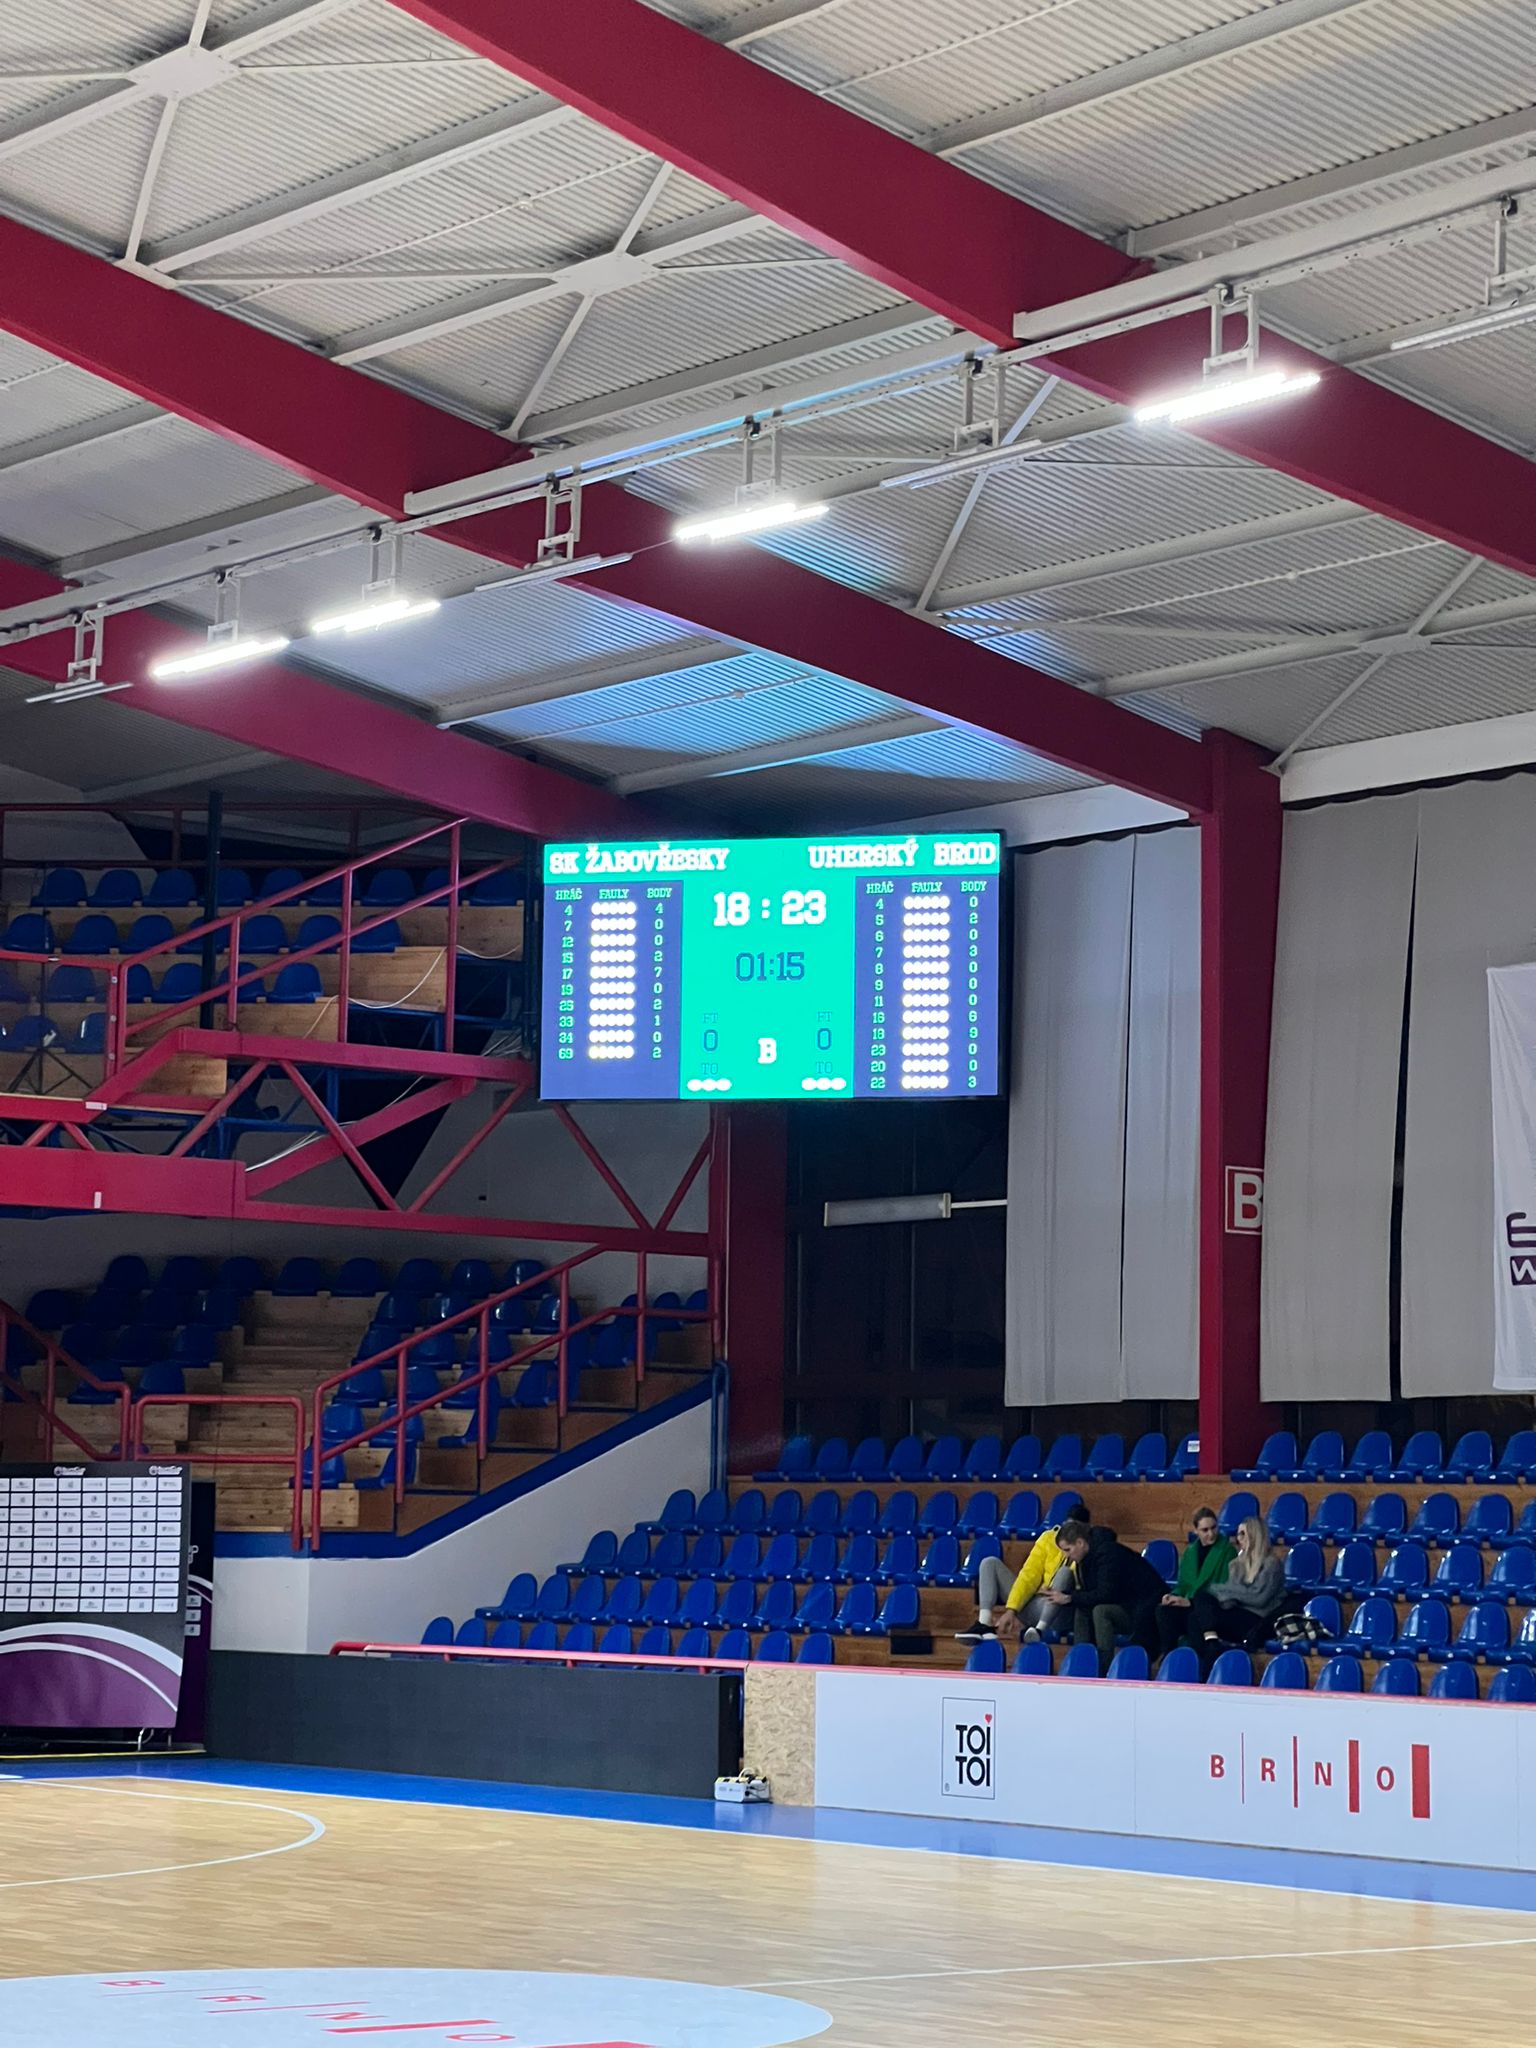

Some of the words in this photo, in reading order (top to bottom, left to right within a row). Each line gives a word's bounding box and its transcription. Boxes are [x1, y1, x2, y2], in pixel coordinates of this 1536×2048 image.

[549, 851, 580, 874] SK
[584, 842, 730, 873] ŽABOVŘESKY
[808, 837, 919, 869] UHERSKÝ
[933, 841, 997, 866] BROD
[555, 888, 582, 900] HRÁČ
[599, 889, 629, 900] FAULY
[647, 887, 672, 899] BODY
[866, 881, 894, 894] HRÁČ
[911, 881, 942, 893] FAULY
[960, 881, 987, 892] BODY
[564, 905, 573, 916] 4
[655, 903, 664, 914] 4
[713, 891, 750, 927] 18
[781, 889, 827, 925] 23
[875, 898, 884, 910] 4
[969, 912, 978, 924] 2
[564, 920, 573, 932] 7
[654, 918, 664, 930] 0
[562, 937, 574, 948] 12
[654, 935, 663, 946] 0
[654, 951, 663, 962] 2
[875, 947, 884, 958] 7
[561, 968, 573, 979] 17
[654, 966, 663, 978] 7
[735, 951, 805, 982] 01:15
[653, 982, 663, 994] 0
[653, 998, 662, 1010] 2
[874, 995, 884, 1007] 11
[559, 1016, 574, 1028] 33
[653, 1015, 661, 1026] 1
[559, 1032, 573, 1044] 34
[653, 1031, 662, 1043] 0
[652, 1047, 662, 1059] 2
[757, 1037, 777, 1065] B
[870, 1044, 886, 1056] 23
[870, 1077, 886, 1089] 22
[955, 1724, 991, 1756] TOI
[955, 1755, 991, 1787] TOI
